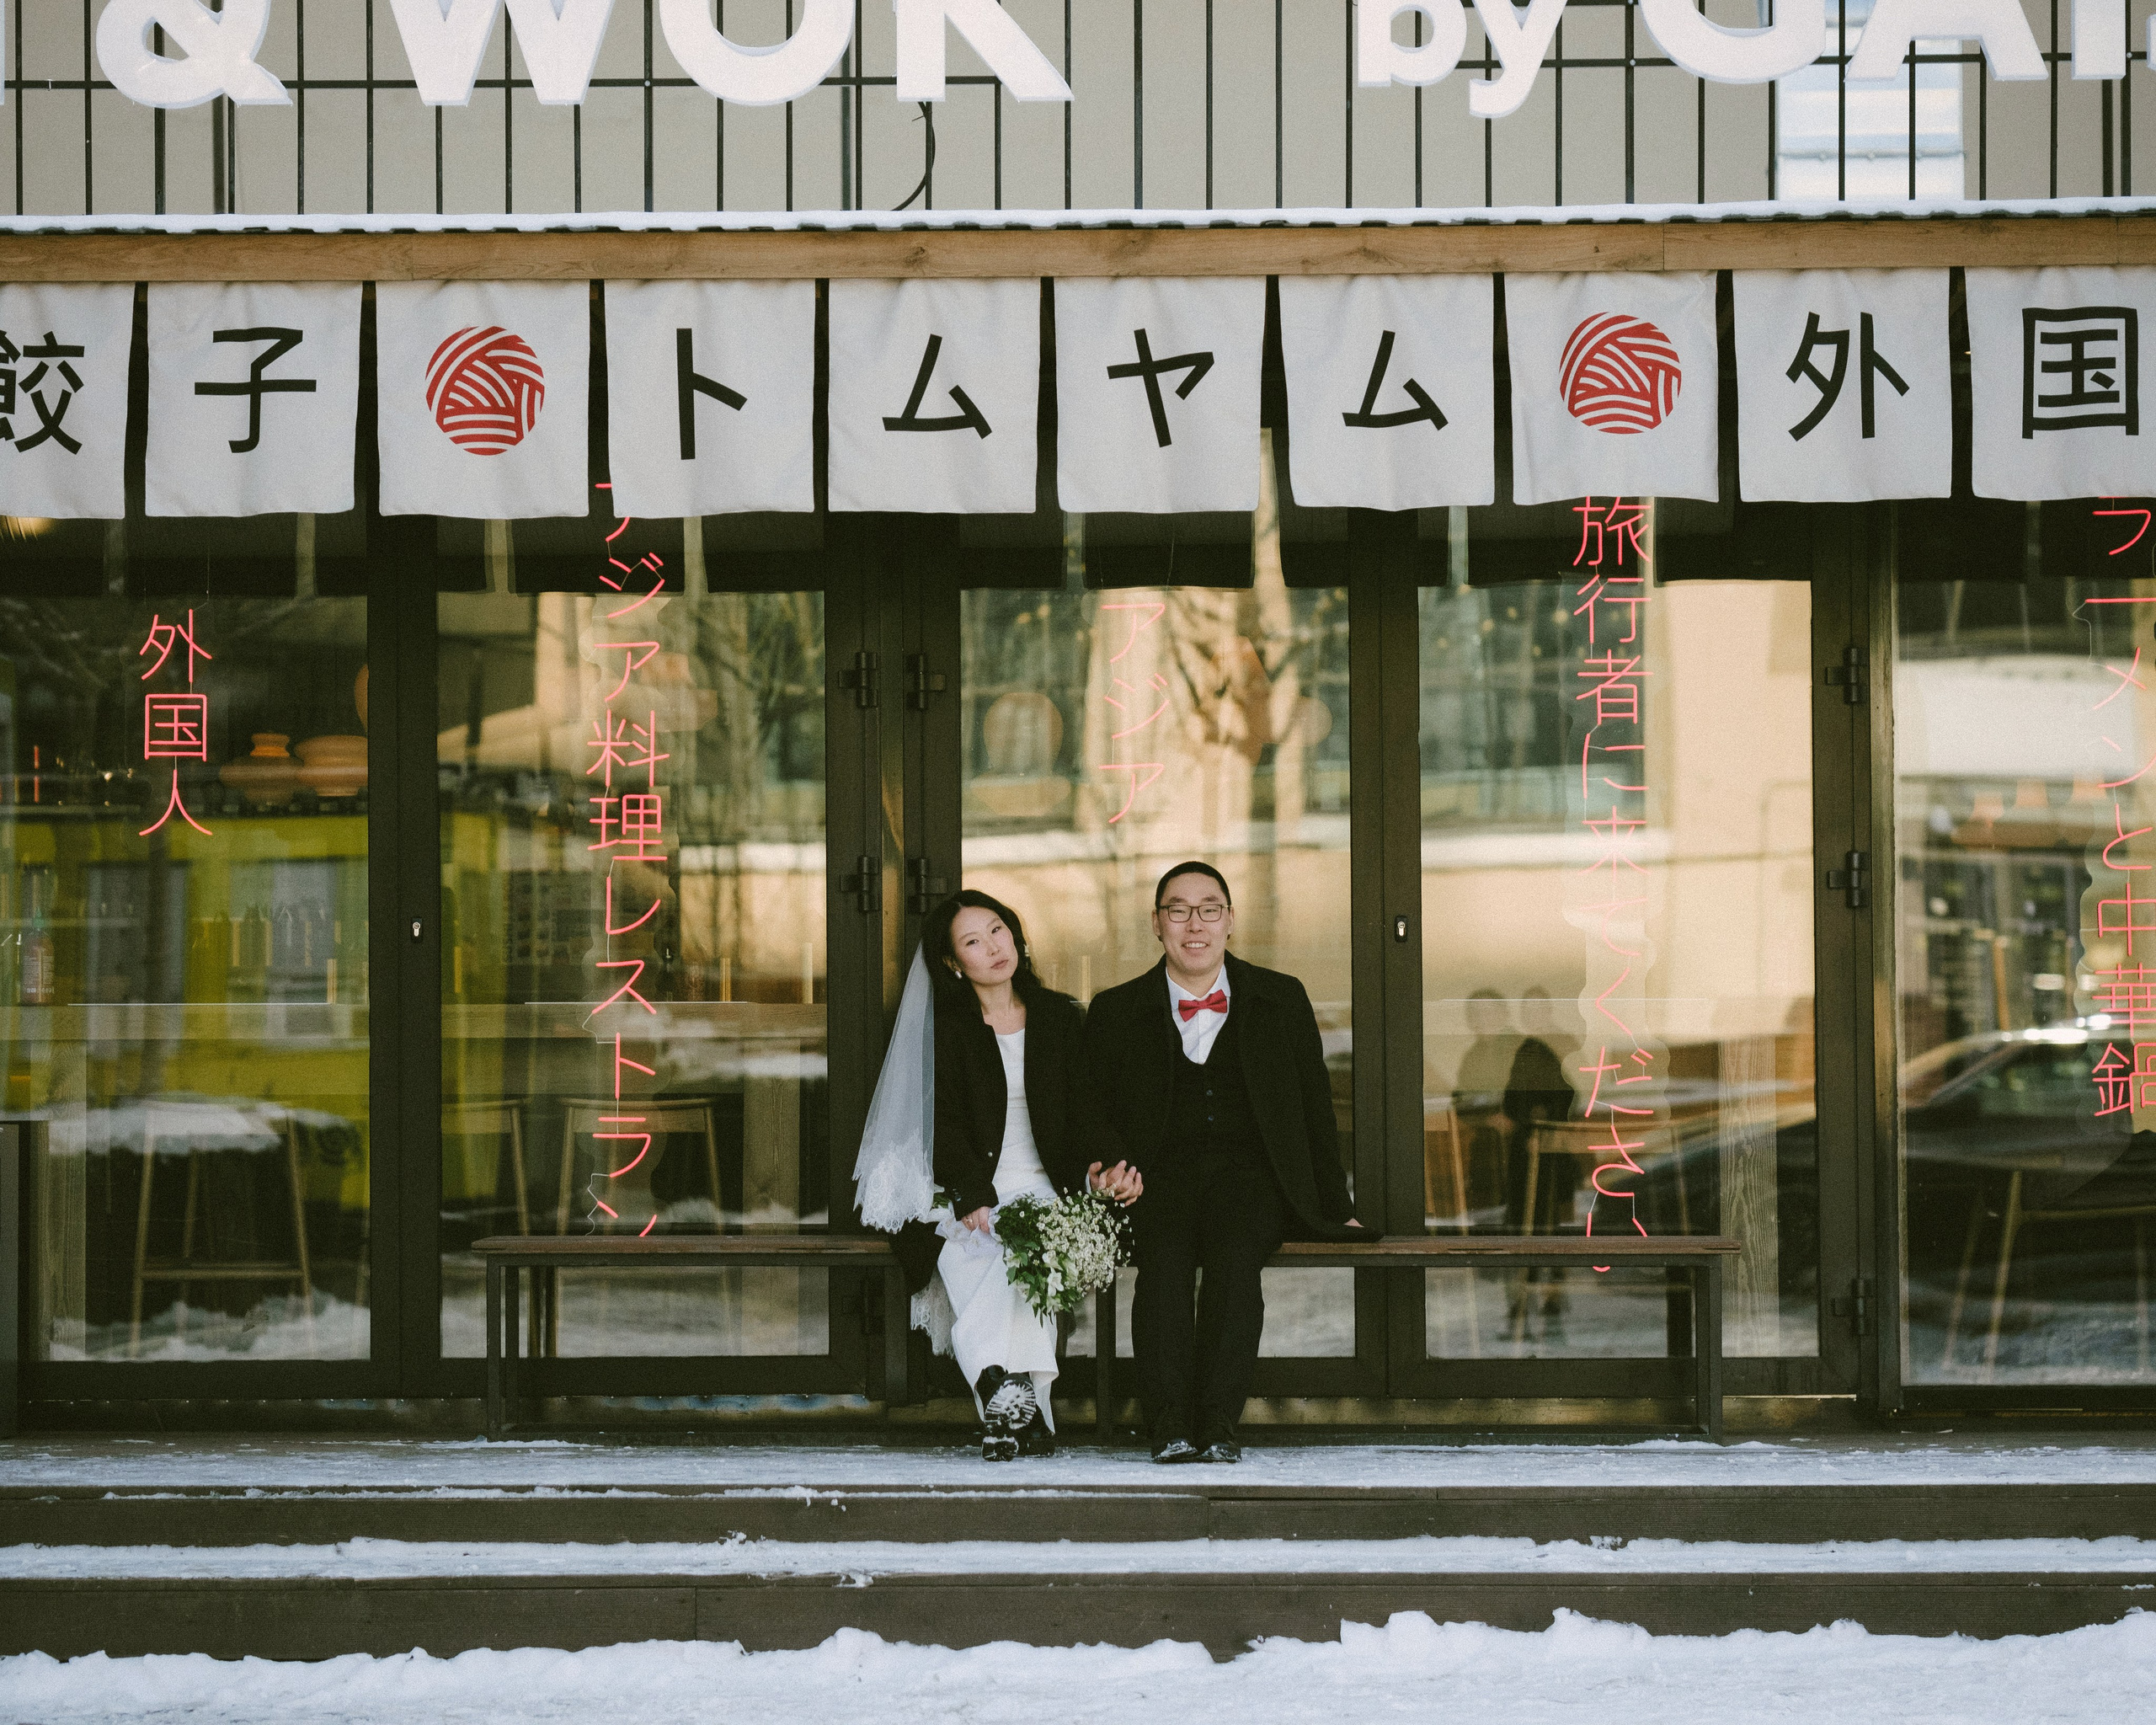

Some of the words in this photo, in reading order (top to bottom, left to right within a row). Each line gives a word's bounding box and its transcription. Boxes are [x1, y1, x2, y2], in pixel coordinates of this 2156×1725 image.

[138, 608, 213, 836] 外国人
[1098, 602, 1170, 825] アジア
